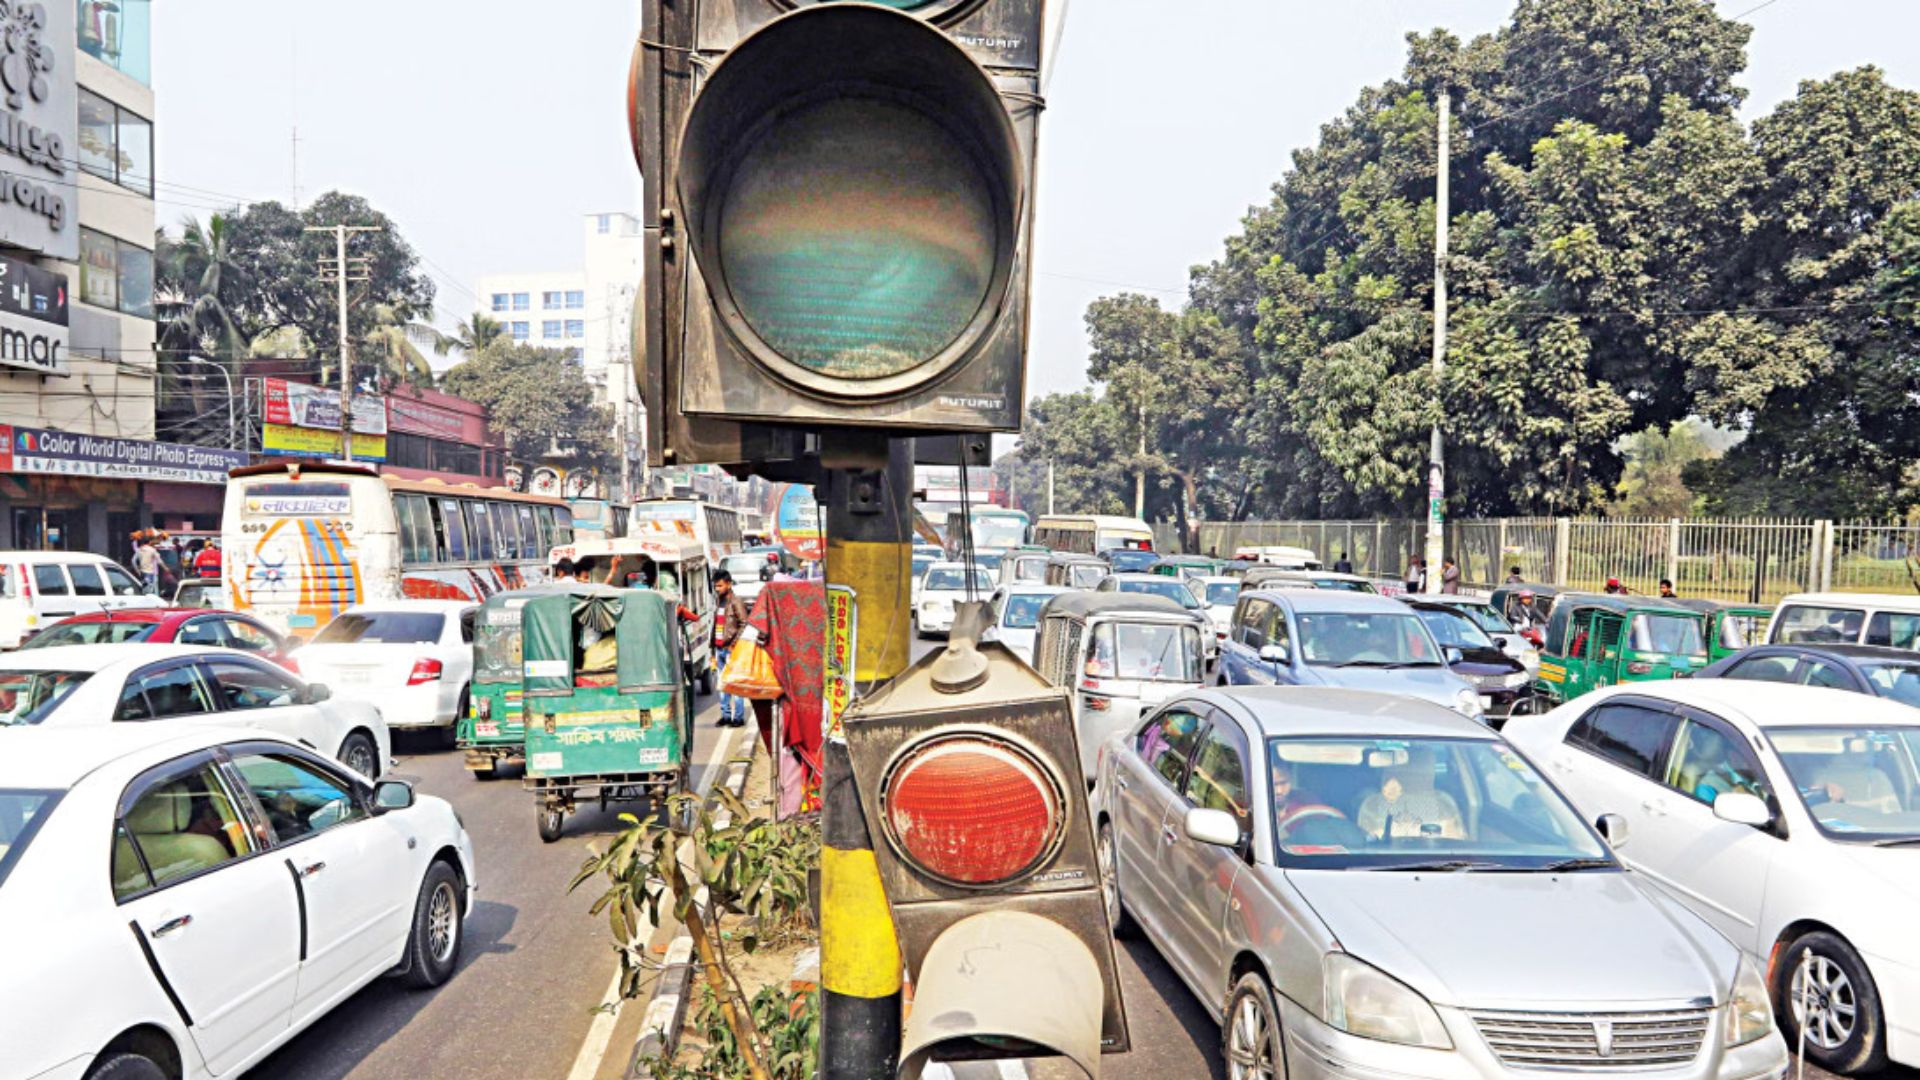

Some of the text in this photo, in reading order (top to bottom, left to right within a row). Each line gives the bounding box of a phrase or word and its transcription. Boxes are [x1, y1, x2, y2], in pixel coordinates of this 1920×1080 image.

[40, 432, 225, 469] Color World Digital Photo Express
